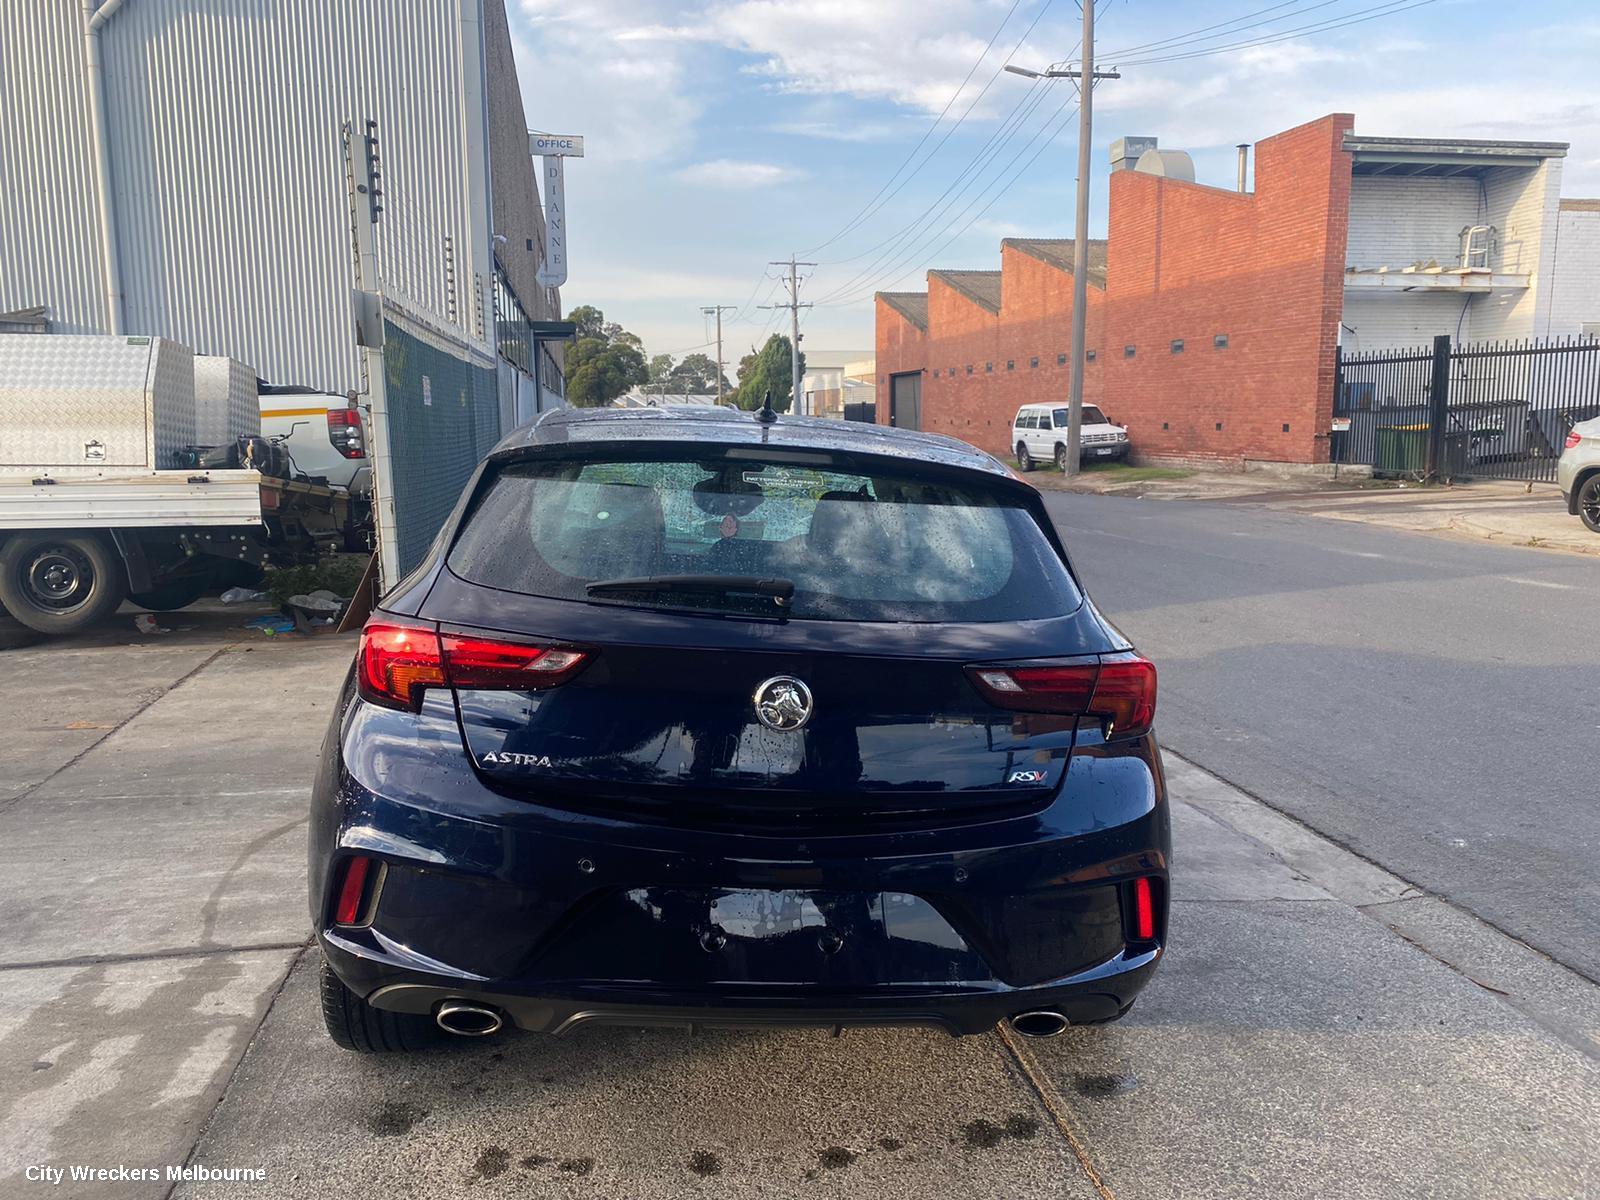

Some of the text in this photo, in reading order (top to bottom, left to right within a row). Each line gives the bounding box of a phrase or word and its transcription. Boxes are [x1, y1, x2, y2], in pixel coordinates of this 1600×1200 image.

[536, 139, 573, 149] OFFICE
[549, 167, 562, 264] DIANNE
[482, 750, 553, 768] ASTRA
[1008, 770, 1048, 783] RSV
